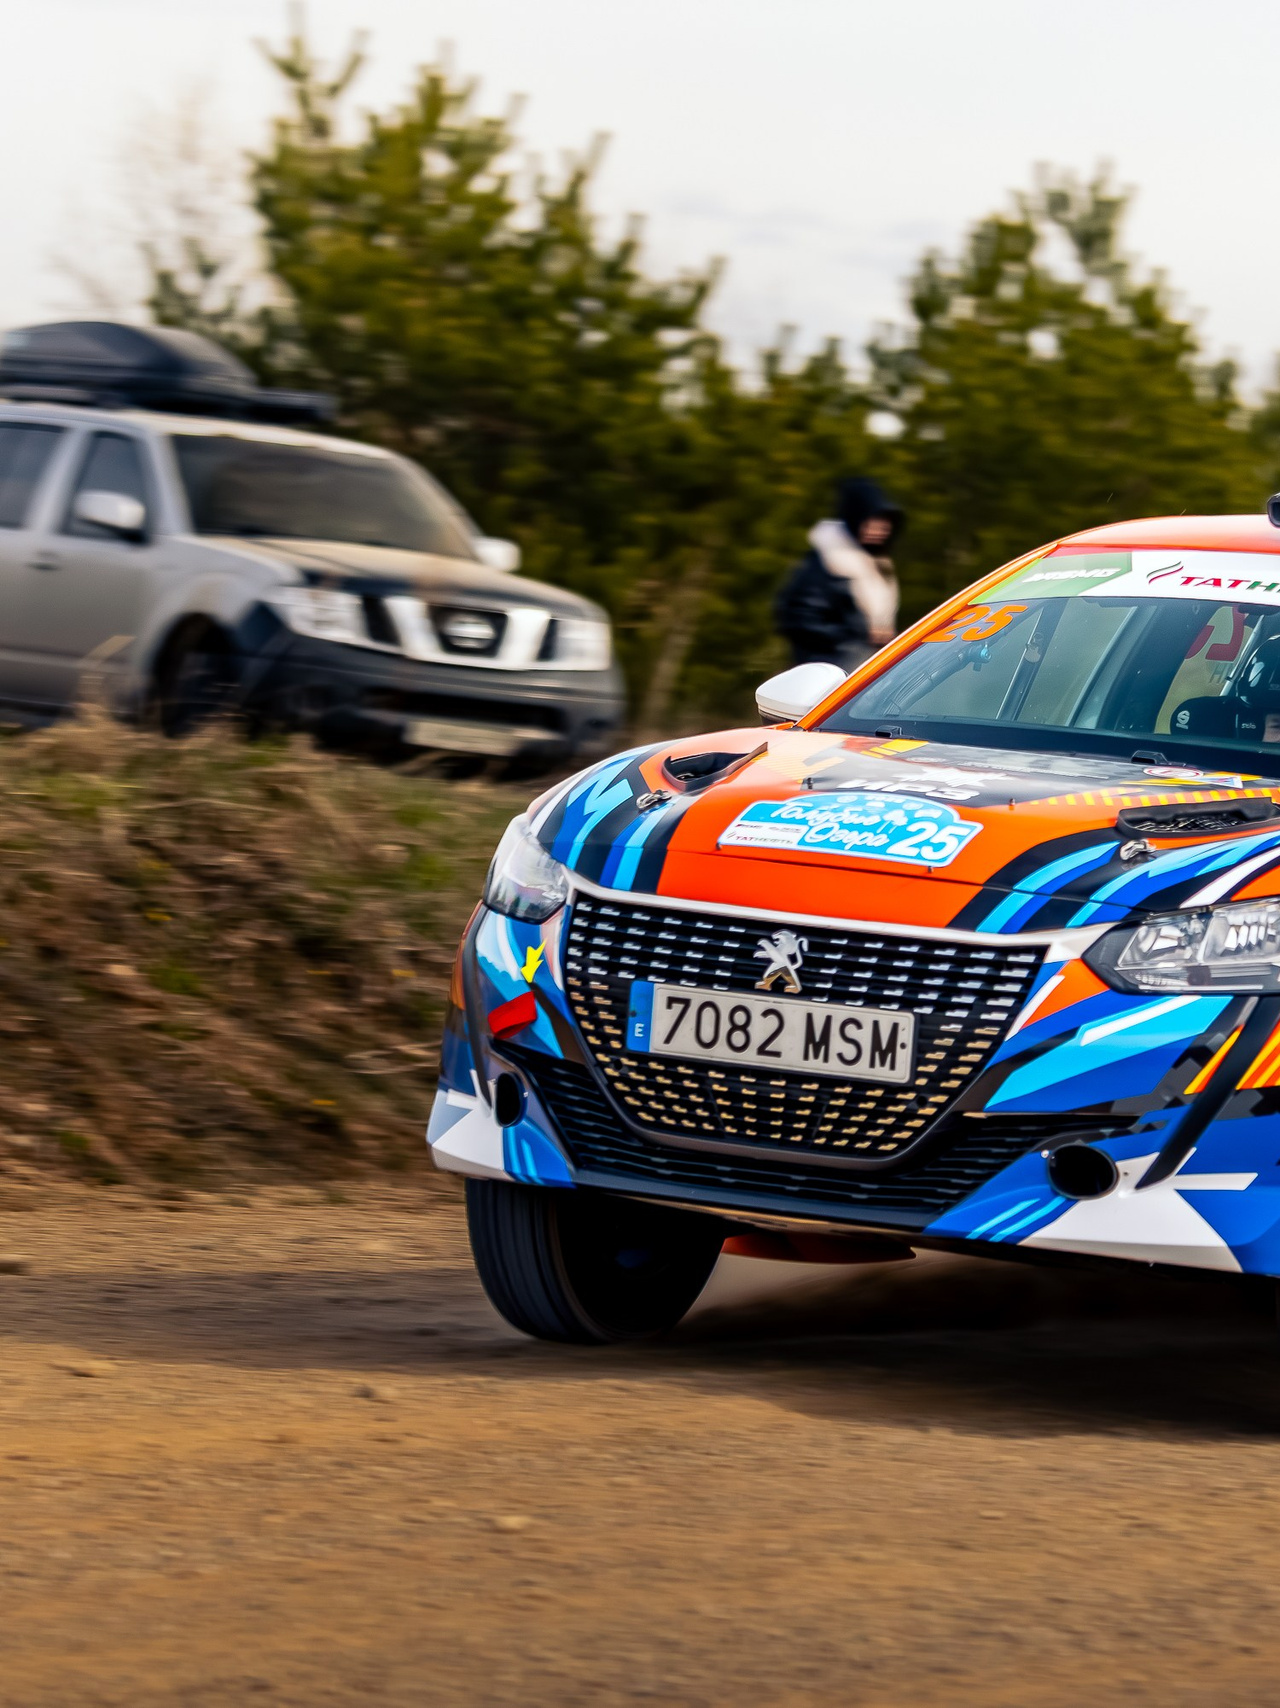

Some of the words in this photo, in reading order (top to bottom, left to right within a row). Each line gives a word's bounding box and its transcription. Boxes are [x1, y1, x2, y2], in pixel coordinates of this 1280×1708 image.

[921, 605, 1028, 643] 25
[886, 821, 973, 861] 25
[634, 1023, 644, 1037] E
[663, 996, 785, 1059] 7082
[803, 1012, 899, 1071] MSM
